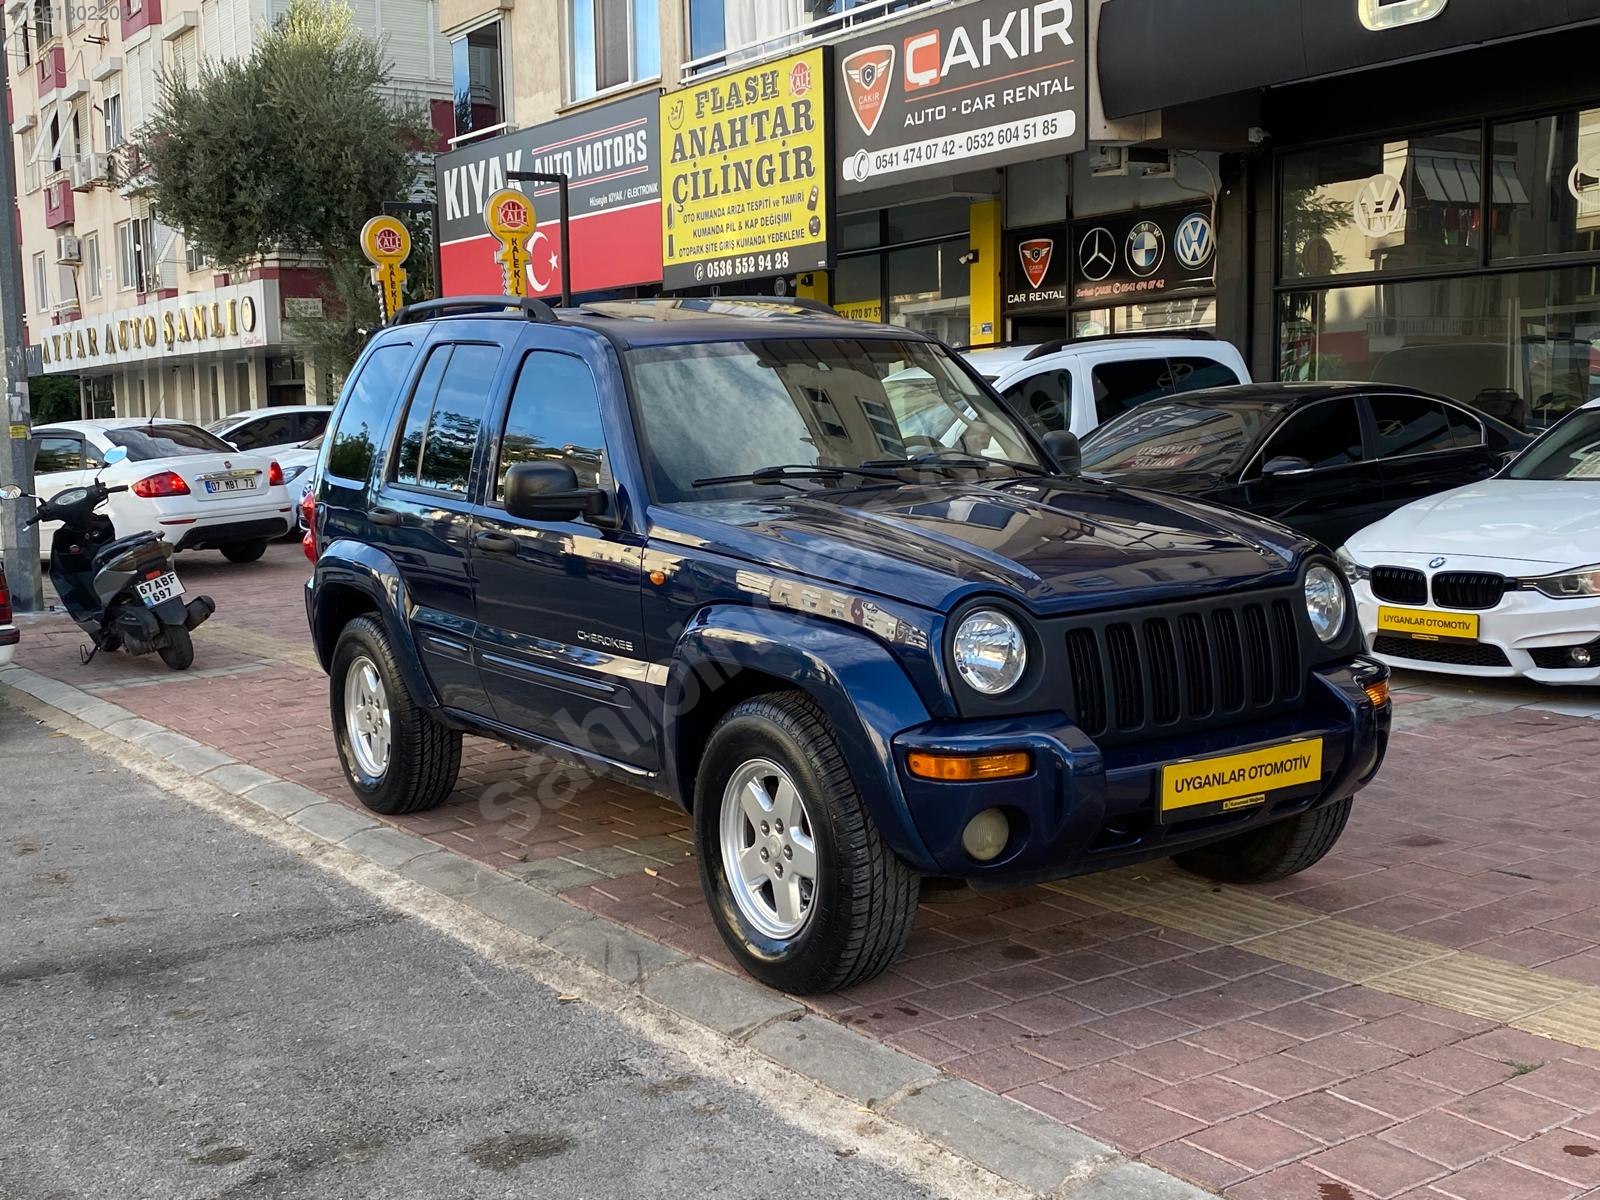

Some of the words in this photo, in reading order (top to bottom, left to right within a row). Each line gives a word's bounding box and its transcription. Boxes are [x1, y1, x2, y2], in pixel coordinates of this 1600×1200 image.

[905, 0, 1075, 86] ÇAKIR
[695, 69, 780, 119] FLASH
[903, 105, 946, 128] AUTO
[960, 94, 996, 116] CAR
[1002, 76, 1076, 108] RENTAL
[670, 99, 815, 164] ANAHTAR
[874, 152, 900, 171] 0541
[902, 148, 923, 166] 474
[925, 143, 940, 161] 07
[941, 139, 956, 157] 42
[965, 133, 995, 153] 0532
[997, 127, 1020, 146] 604
[1022, 123, 1039, 140] 51
[1041, 117, 1058, 136] 85
[443, 148, 523, 221] KIYAK
[533, 150, 573, 187] AUTO
[576, 129, 648, 177] MOTORS
[671, 139, 816, 213] ÇİLİNGİR
[608, 189, 624, 203] KIYAK
[497, 207, 529, 226] KALE
[683, 213, 695, 224] OTO
[696, 207, 726, 222] KUMANDA
[726, 203, 746, 216] ARIZA
[772, 199, 780, 208] ve
[692, 224, 725, 239] KUMANDA
[725, 219, 736, 233] PİL
[737, 220, 743, 231] &
[744, 216, 759, 230] KAP
[374, 235, 403, 251] KALE
[678, 245, 705, 258] OTOPARK
[736, 233, 766, 249] KUMANDA
[767, 228, 805, 244] YEDEKLEME
[706, 259, 733, 279] 0536
[735, 256, 755, 275] 552
[758, 253, 772, 272] 94
[774, 250, 789, 270] 28
[1156, 279, 1165, 289] 42
[1007, 293, 1026, 304] CAR
[1028, 290, 1065, 302] RENTAL
[863, 307, 872, 319] 87
[873, 306, 882, 317] 57
[105, 314, 157, 354] AUTO
[162, 298, 239, 352] ŞANLI
[211, 481, 220, 491] 07
[243, 478, 254, 488] 73
[139, 582, 152, 595] 67
[154, 573, 175, 590] ABF
[152, 587, 172, 602] 697
[1383, 614, 1425, 627] UYGANLAR
[1426, 618, 1472, 631] OTOMOTİV
[576, 629, 634, 652] CHEROKEE
[1174, 767, 1246, 793] UYGANLAR
[1248, 753, 1312, 780] OTOMOTİV
